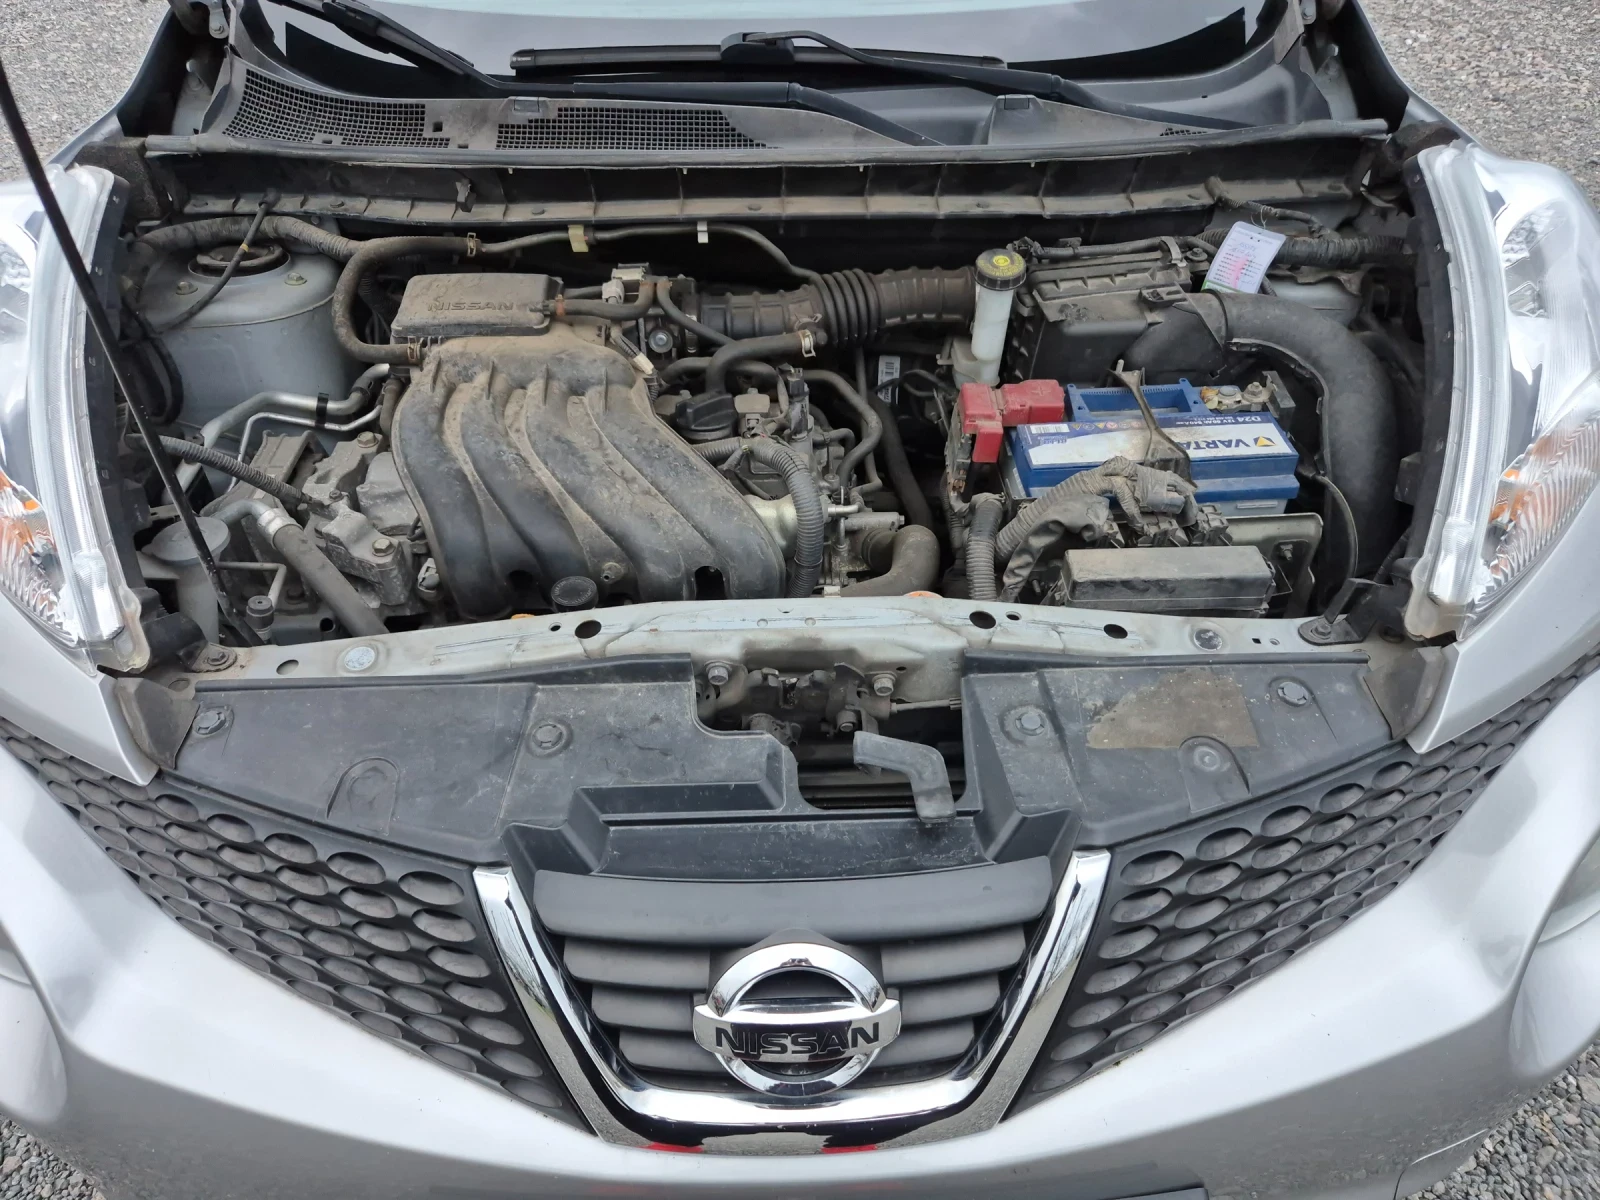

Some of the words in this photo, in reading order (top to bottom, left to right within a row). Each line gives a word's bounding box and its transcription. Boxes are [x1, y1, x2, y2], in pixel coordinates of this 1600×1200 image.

[427, 301, 514, 312] NISSAN
[1177, 438, 1251, 450] VARTA
[715, 1021, 880, 1055] NISSAN
